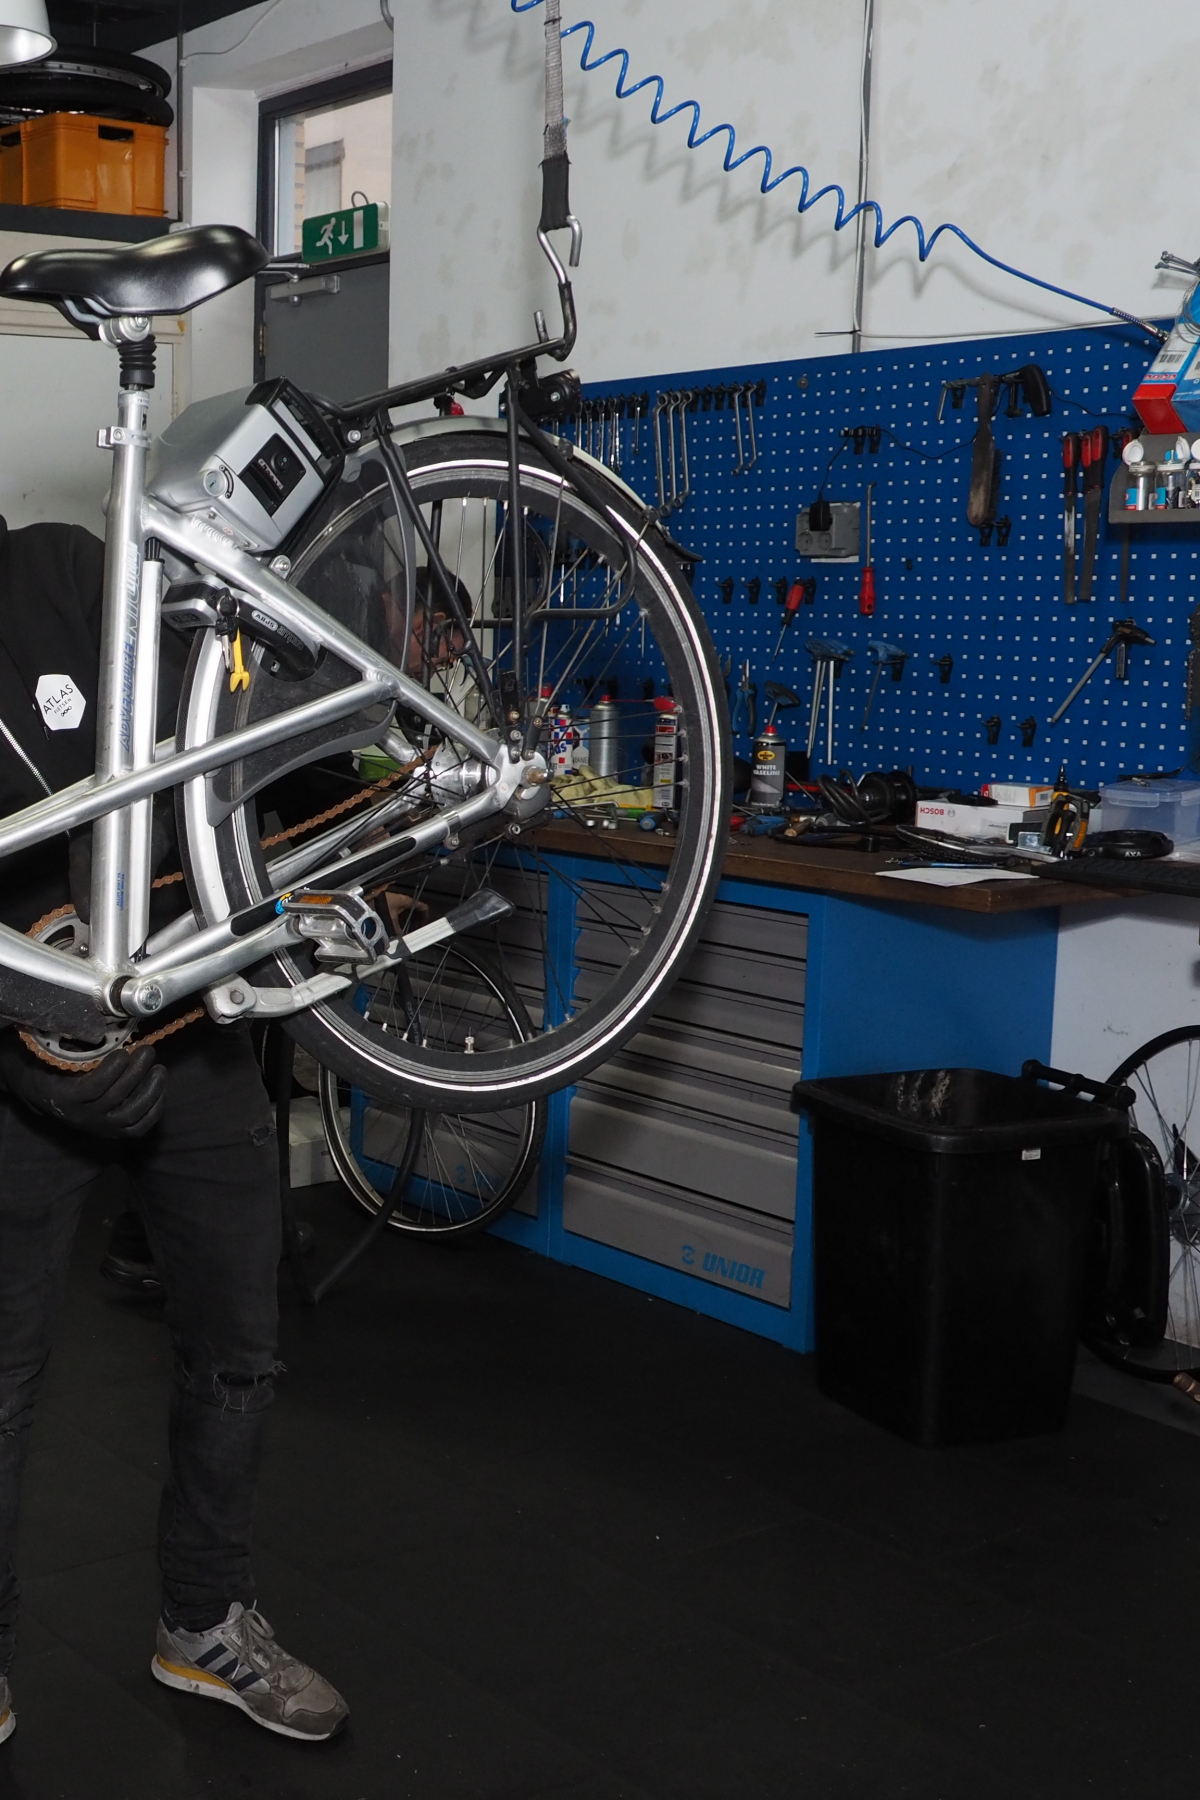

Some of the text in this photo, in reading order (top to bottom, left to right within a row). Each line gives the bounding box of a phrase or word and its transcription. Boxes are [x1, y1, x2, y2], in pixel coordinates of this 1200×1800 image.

[254, 613, 275, 628] ABUS
[43, 684, 74, 715] ATLAS
[920, 806, 945, 816] BOSCH
[702, 1252, 766, 1289] UNIOR
